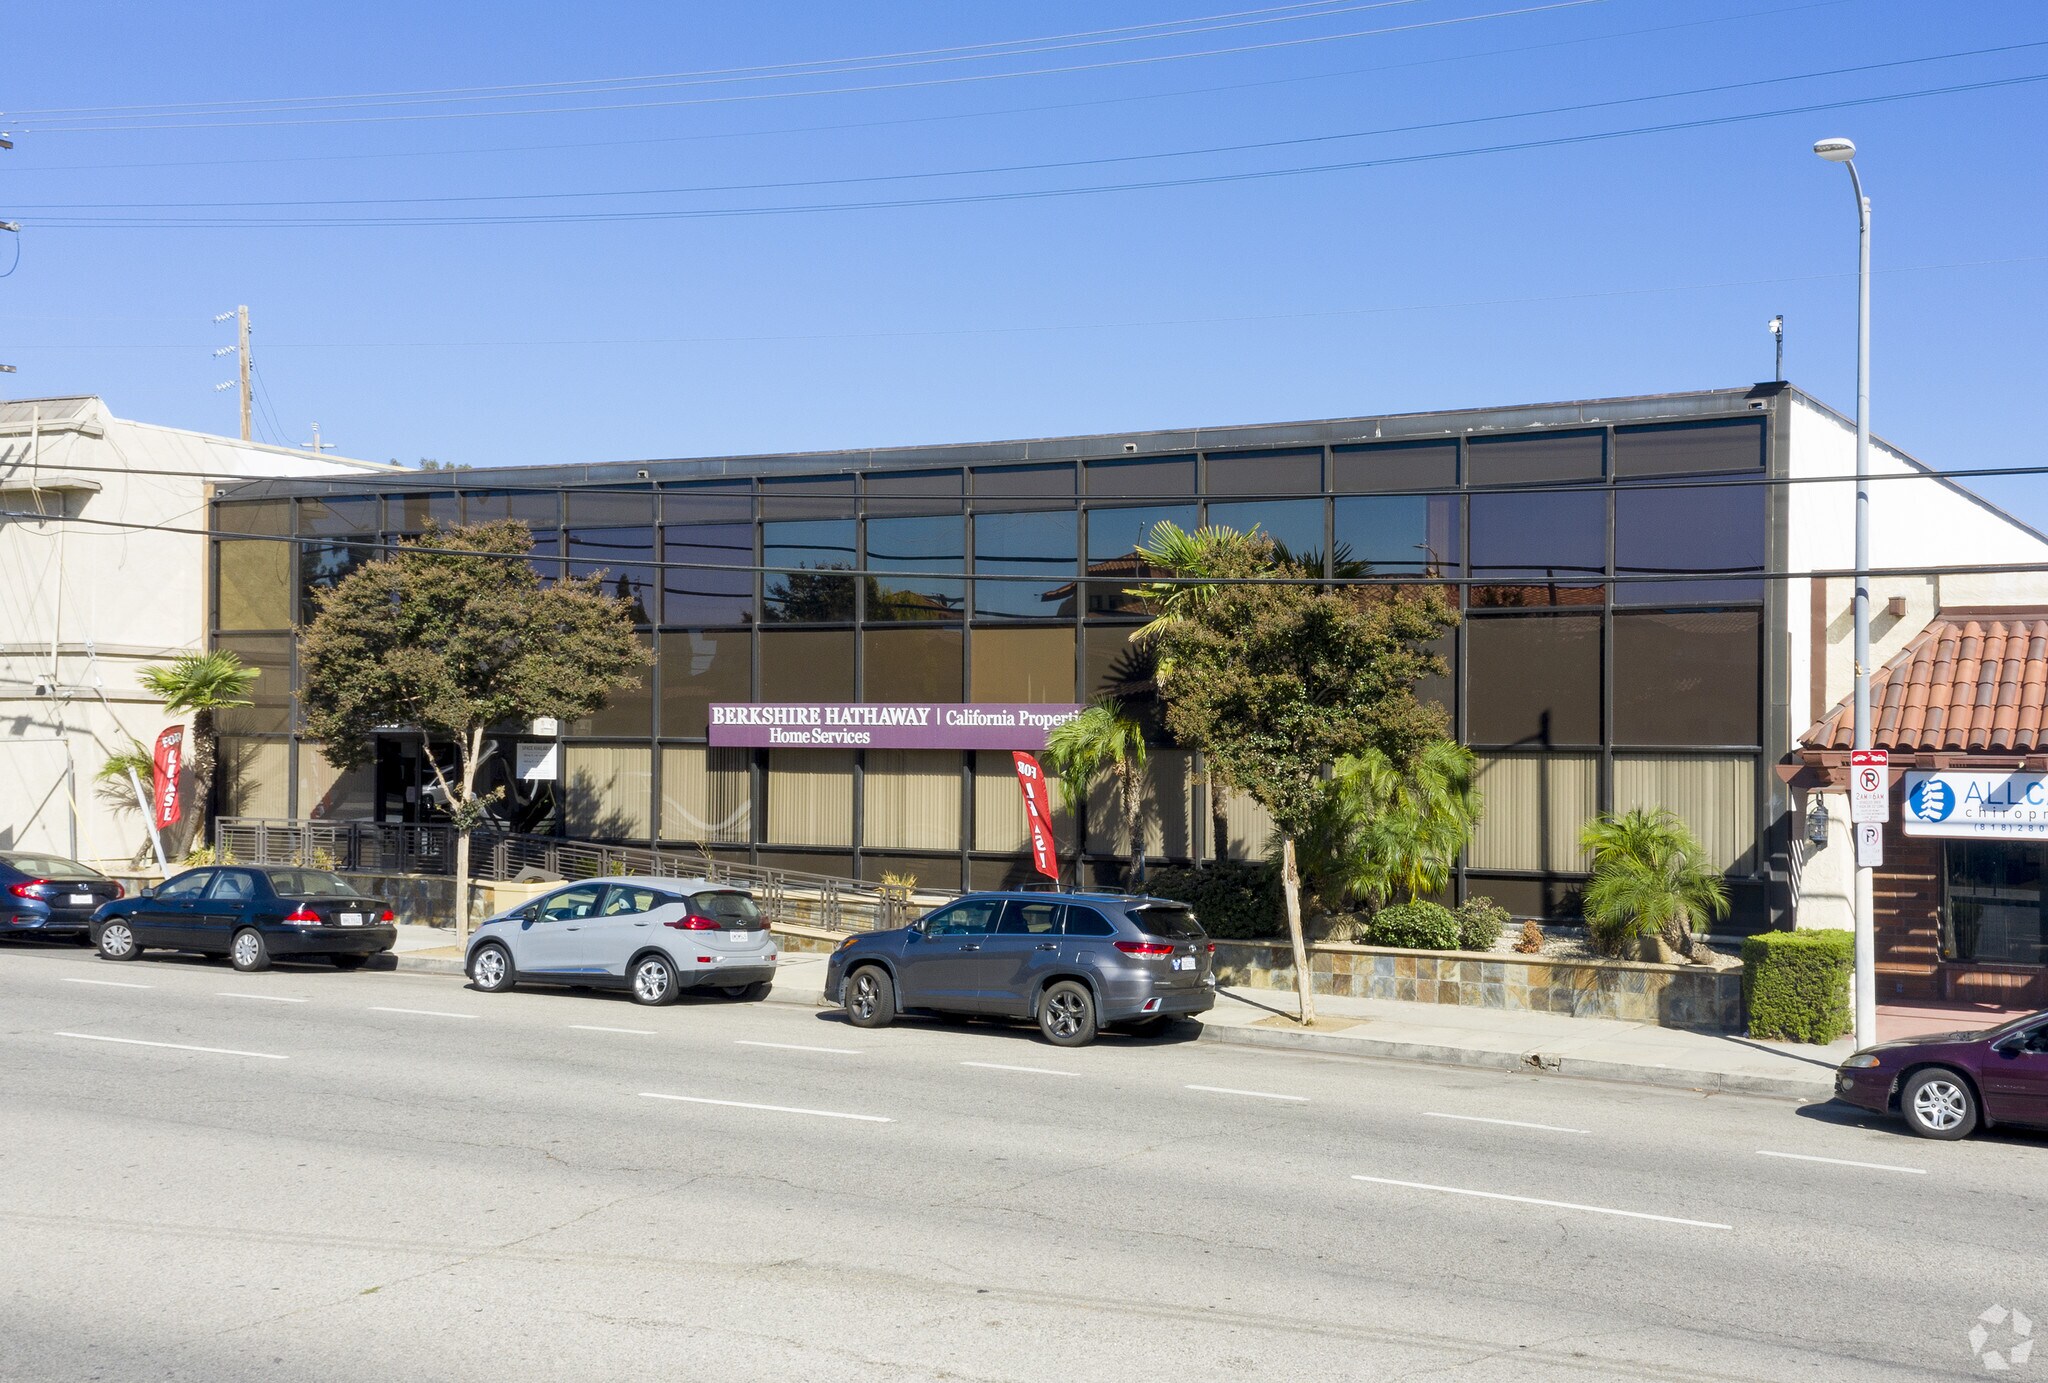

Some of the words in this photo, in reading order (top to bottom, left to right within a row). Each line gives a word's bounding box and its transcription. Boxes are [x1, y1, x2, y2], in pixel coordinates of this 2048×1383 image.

[712, 707, 821, 725] BERKSHIRE
[824, 707, 931, 726] HATHAWAY
[946, 709, 1016, 726] California
[1018, 709, 1081, 730] Properti
[162, 732, 182, 748] FOR
[163, 749, 177, 821] LEASE
[1964, 780, 2048, 805] ALLC
